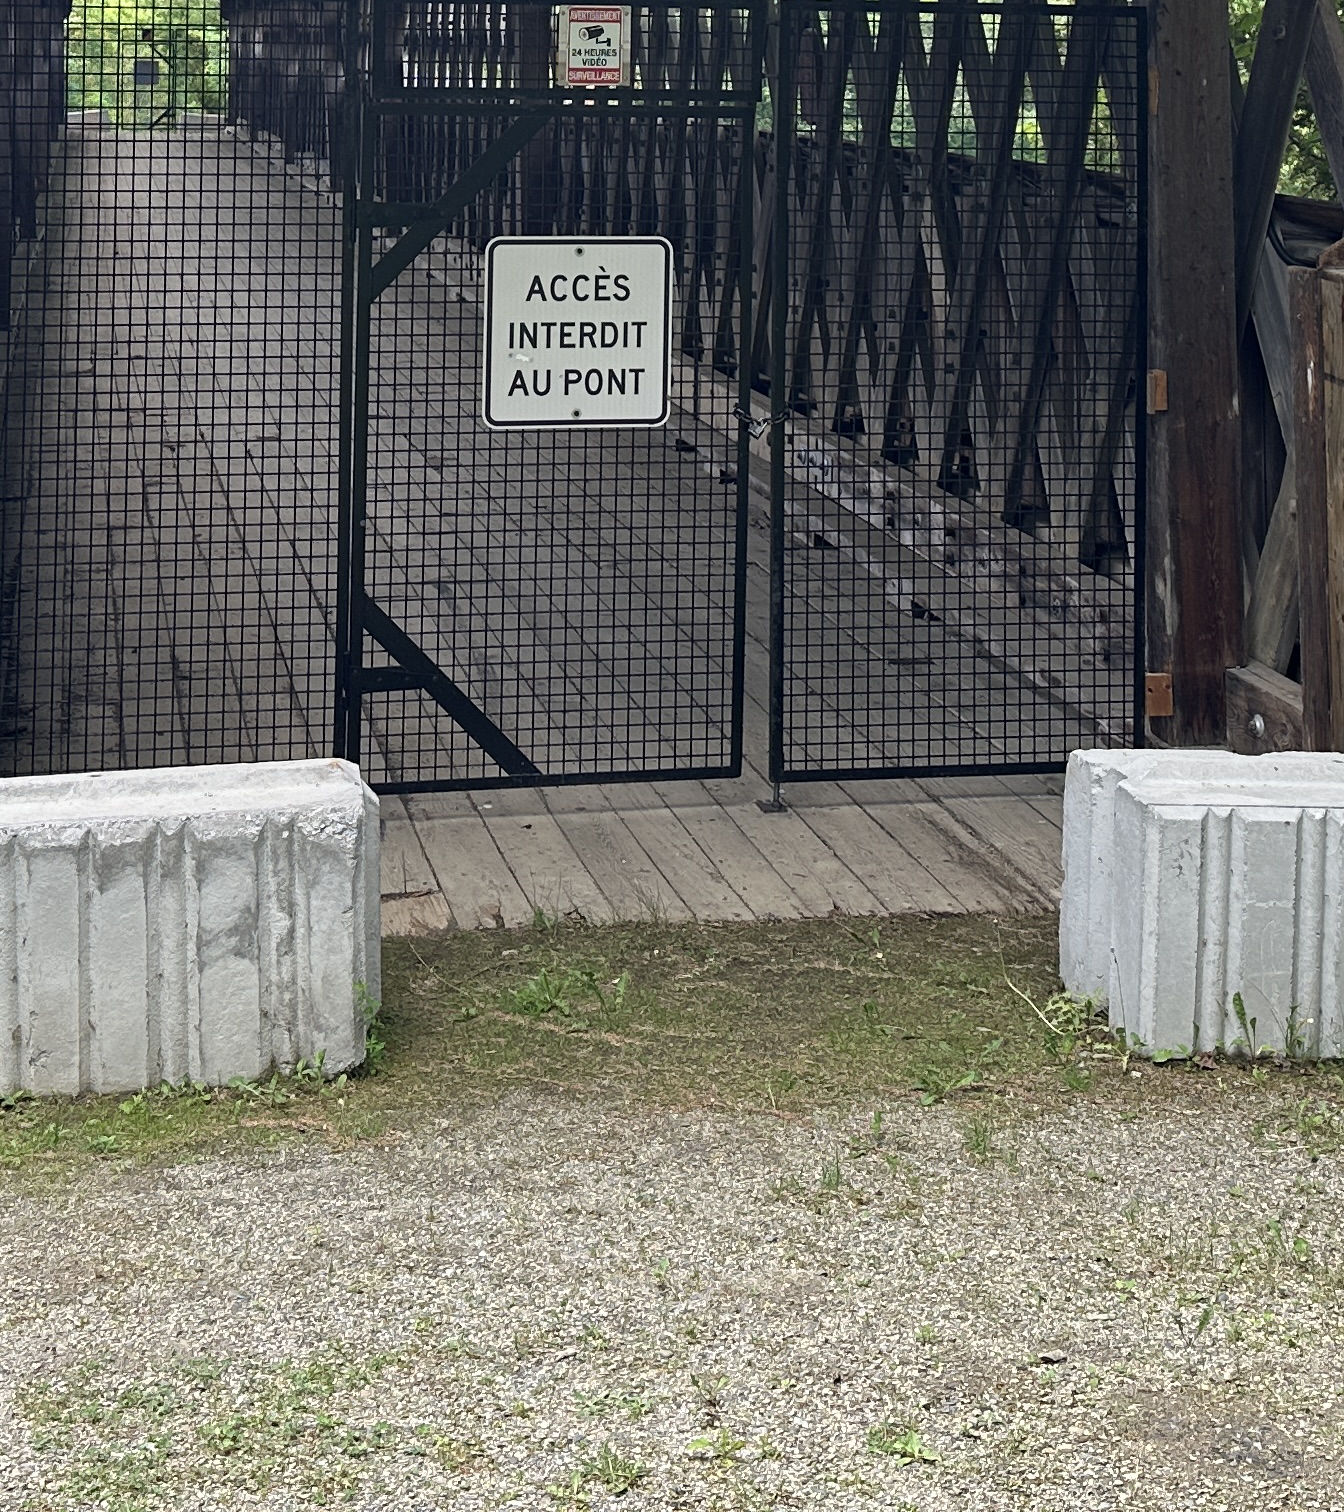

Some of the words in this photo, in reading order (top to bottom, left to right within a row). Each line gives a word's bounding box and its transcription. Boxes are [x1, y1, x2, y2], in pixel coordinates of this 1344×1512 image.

[571, 48, 582, 56] 24
[584, 48, 617, 57] HEURES
[582, 57, 607, 66] VIDÉO
[569, 71, 620, 81] SURVEILLANCE
[525, 265, 631, 302] ACCÈS
[509, 321, 648, 349] INTERDIT
[507, 369, 552, 397] AU
[563, 368, 646, 396] PONT
